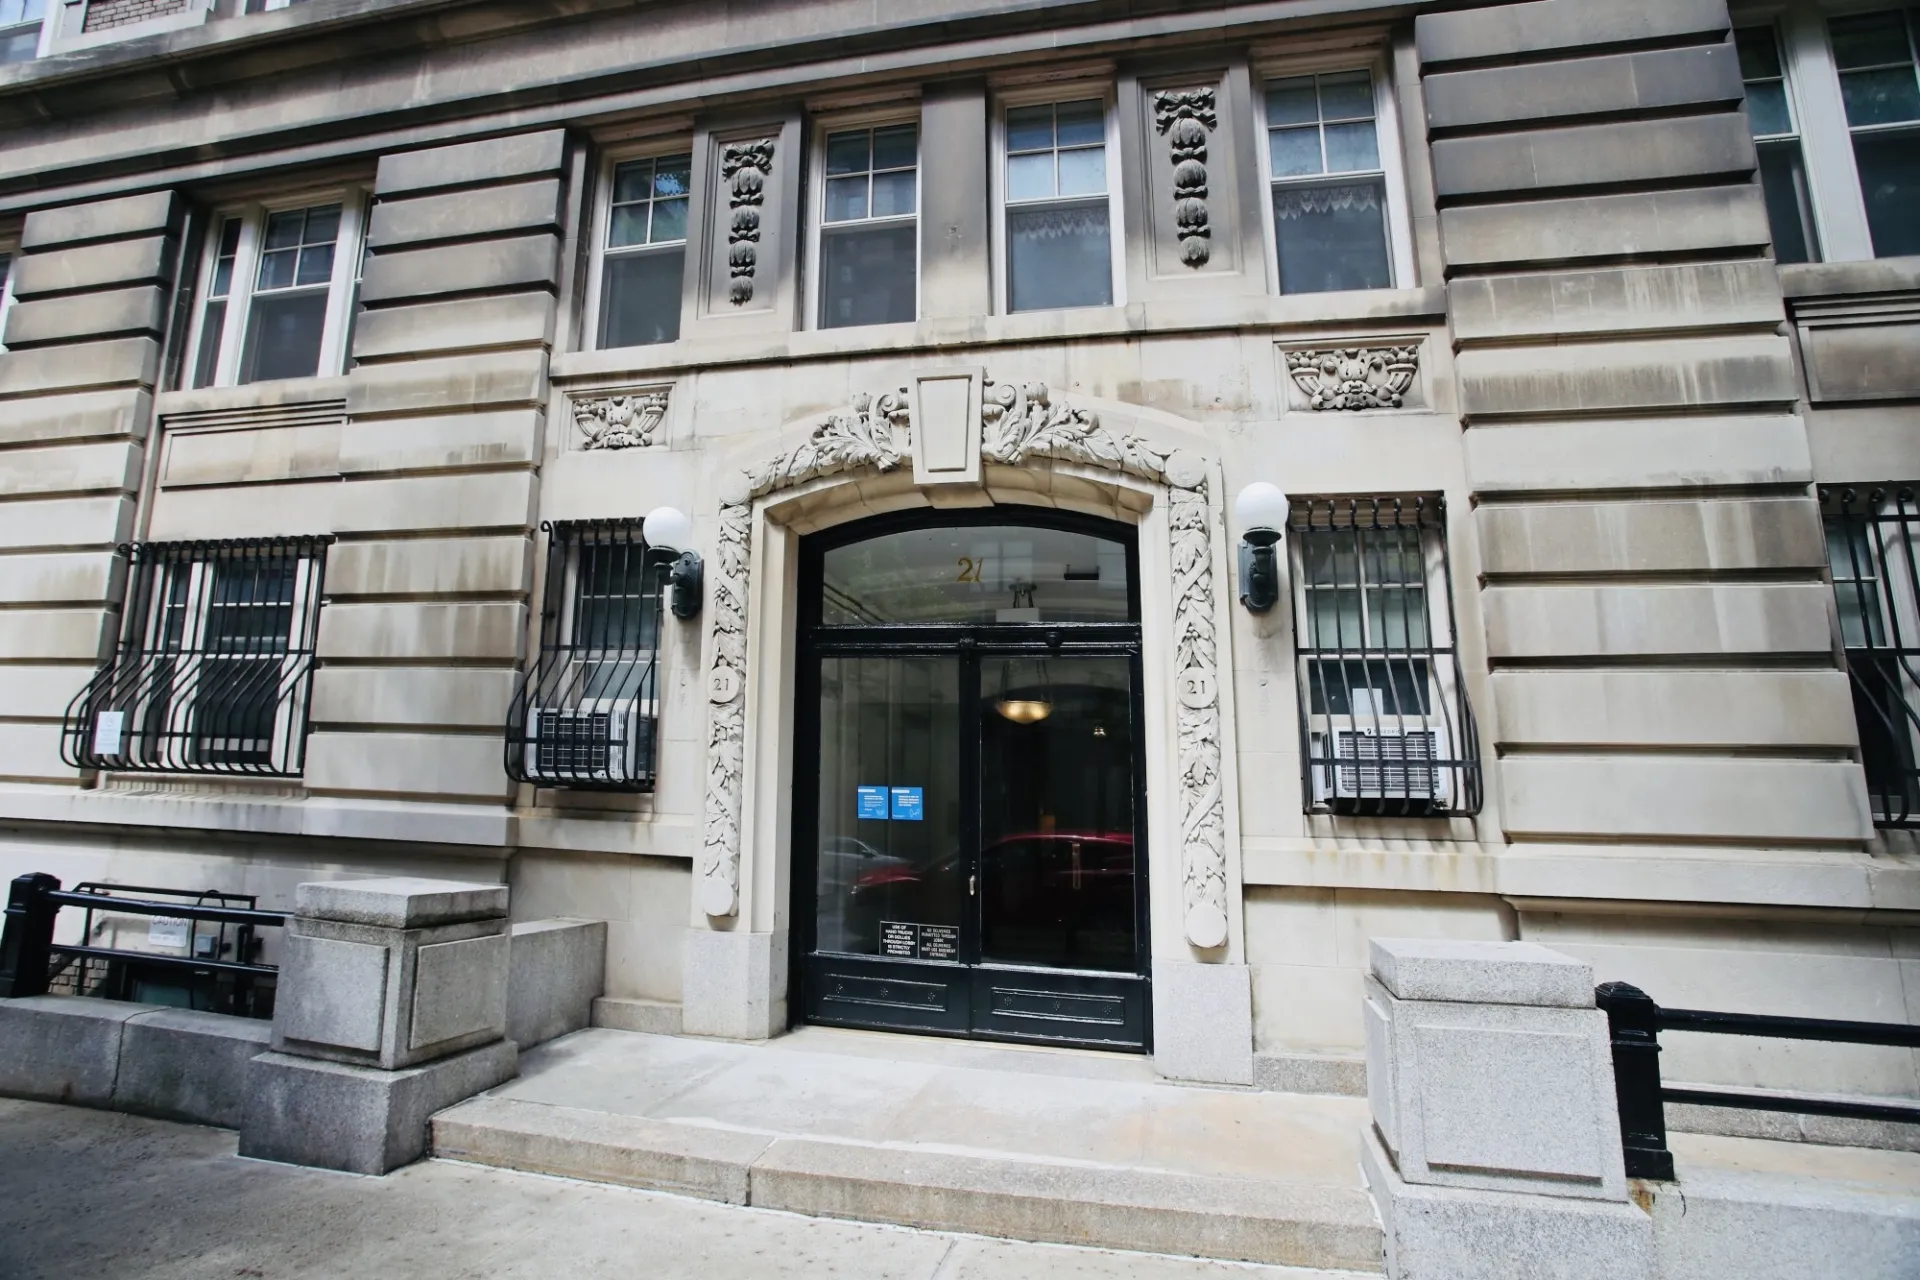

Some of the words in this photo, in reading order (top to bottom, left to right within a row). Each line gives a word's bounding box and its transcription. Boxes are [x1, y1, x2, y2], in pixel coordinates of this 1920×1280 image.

[957, 557, 983, 582] 21
[713, 678, 729, 691] 21
[1187, 680, 1205, 694] 21
[152, 916, 187, 927] CAUTION
